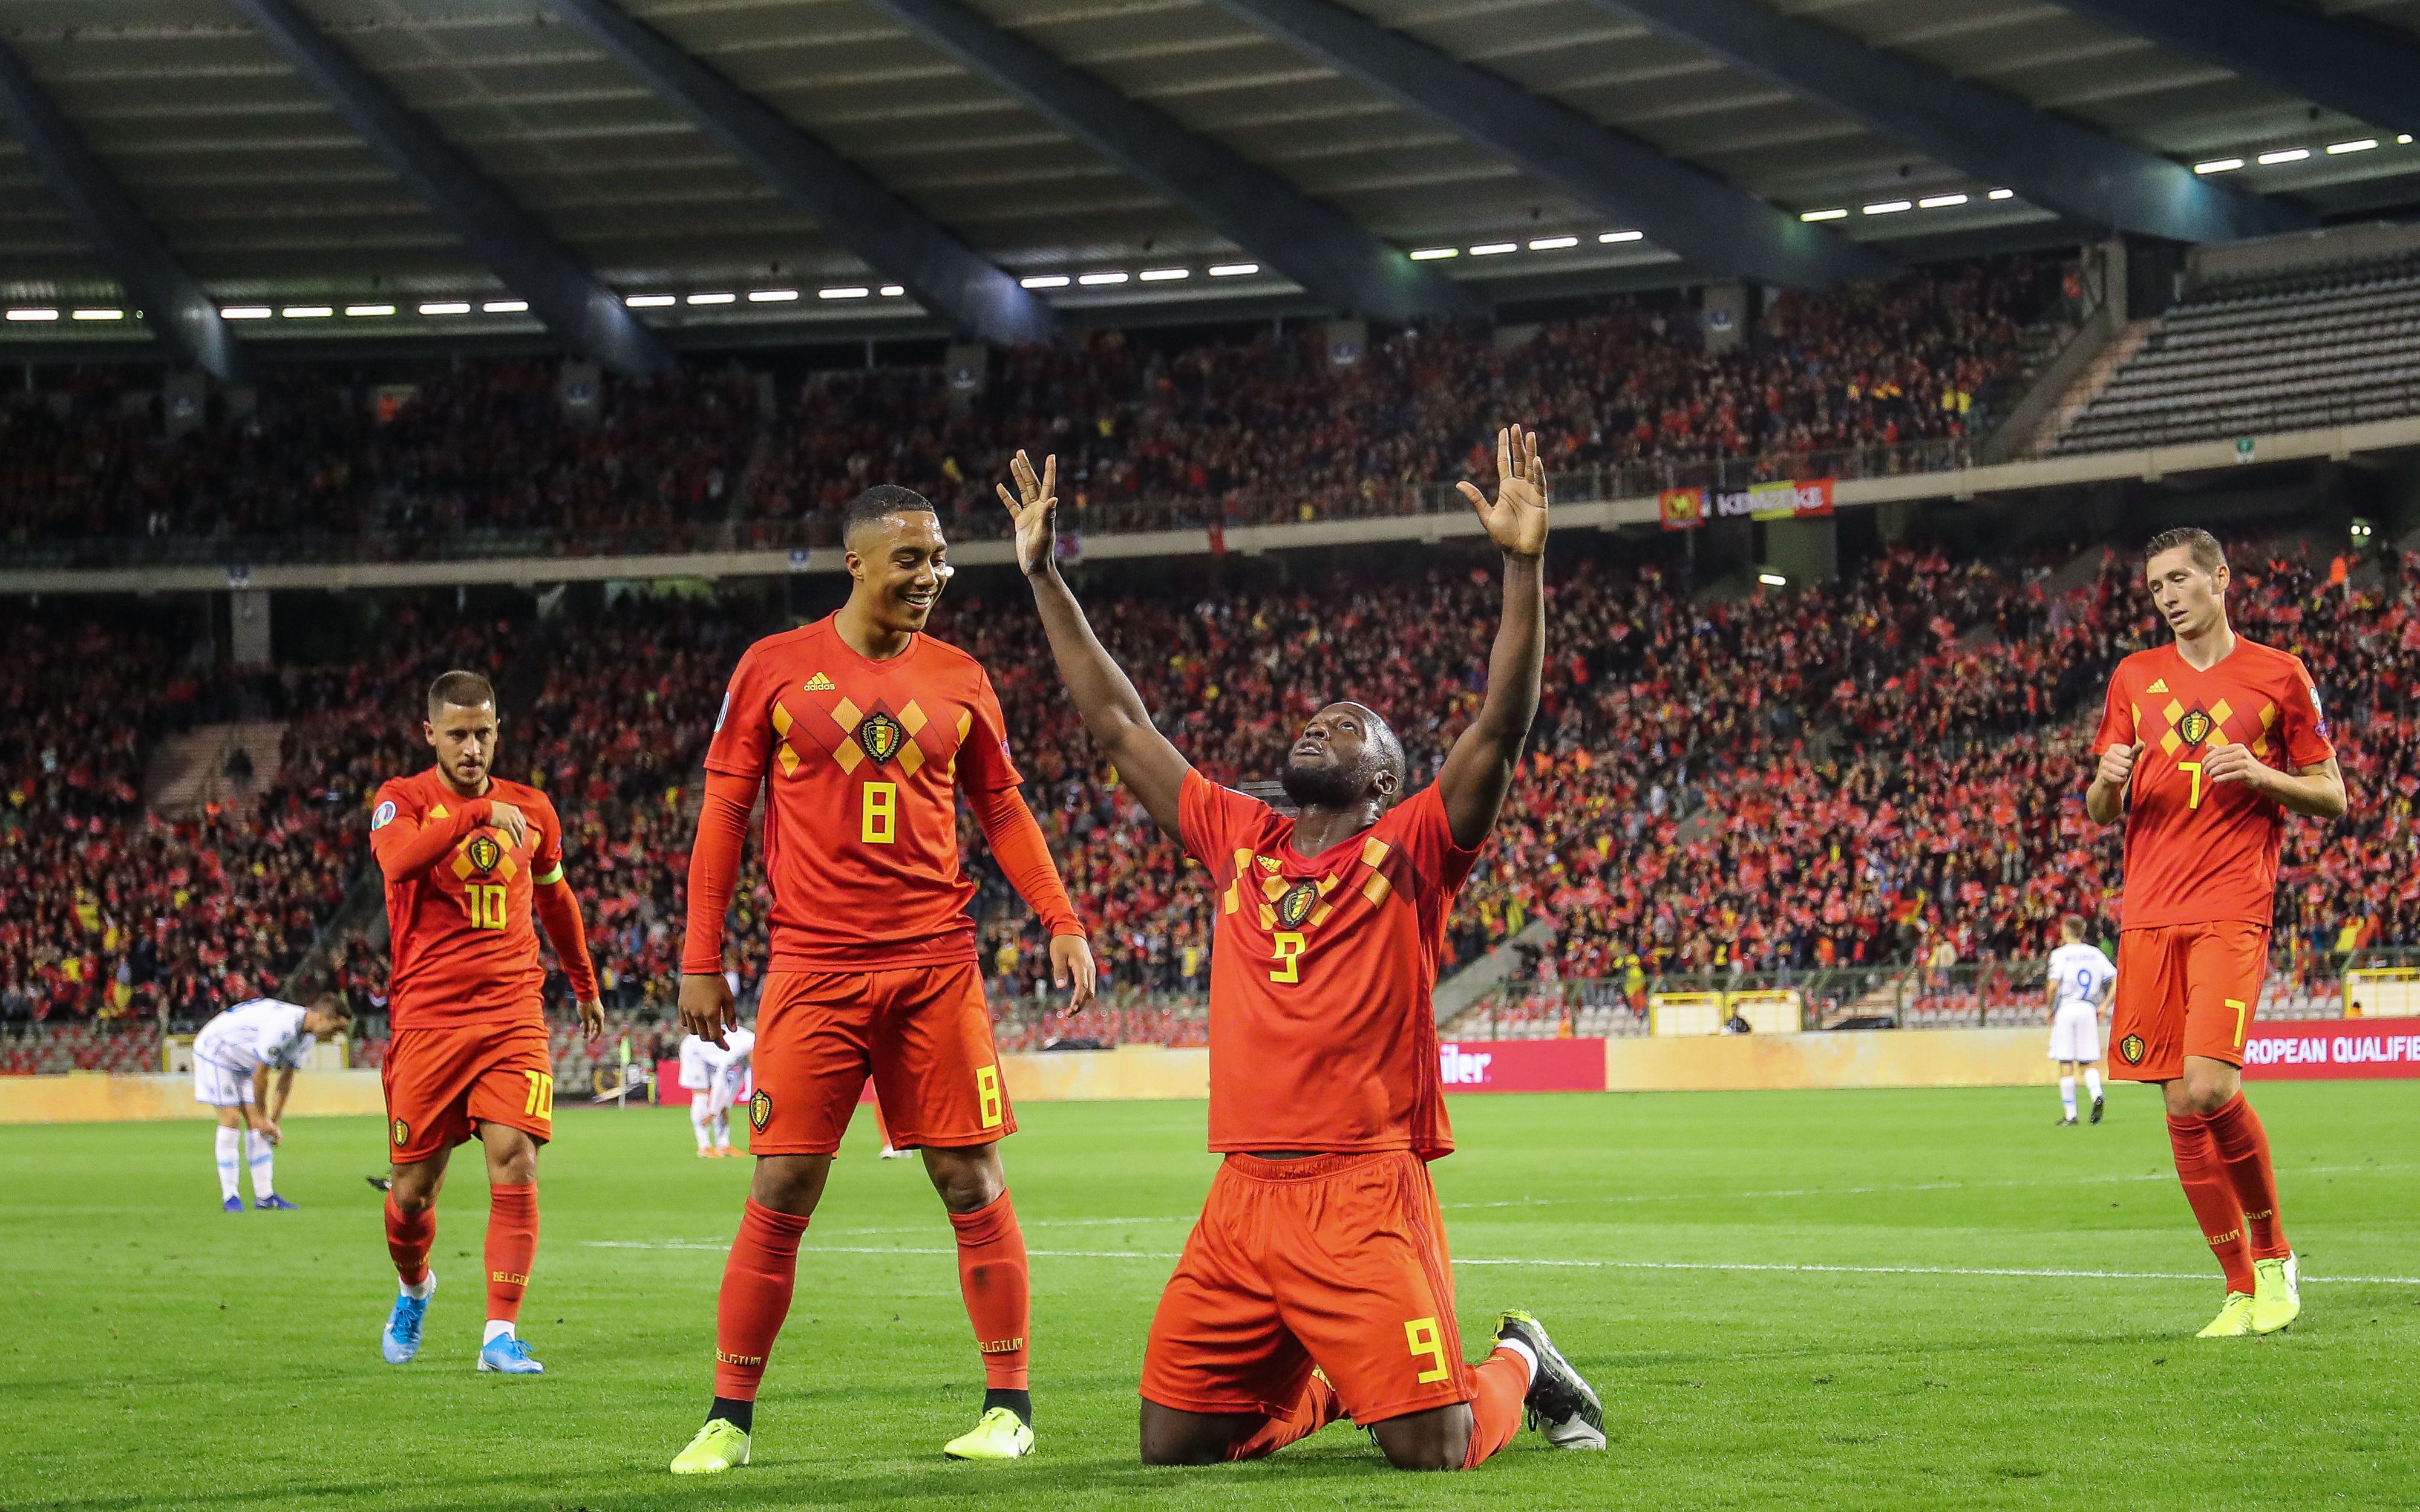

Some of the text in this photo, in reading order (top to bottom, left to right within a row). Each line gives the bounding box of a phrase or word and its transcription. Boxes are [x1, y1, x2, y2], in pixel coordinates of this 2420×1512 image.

[803, 683, 836, 691] adidas
[2178, 761, 2202, 809] 7
[862, 781, 897, 844] 8
[464, 884, 507, 930] 10
[1269, 932, 1306, 983] 9
[2078, 969, 2091, 1000] 9
[2224, 999, 2246, 1048] 7
[524, 1070, 553, 1122] 10
[975, 1064, 1002, 1129] 8
[978, 1337, 1024, 1353] ELGIUM
[1404, 1317, 1449, 1384] 9
